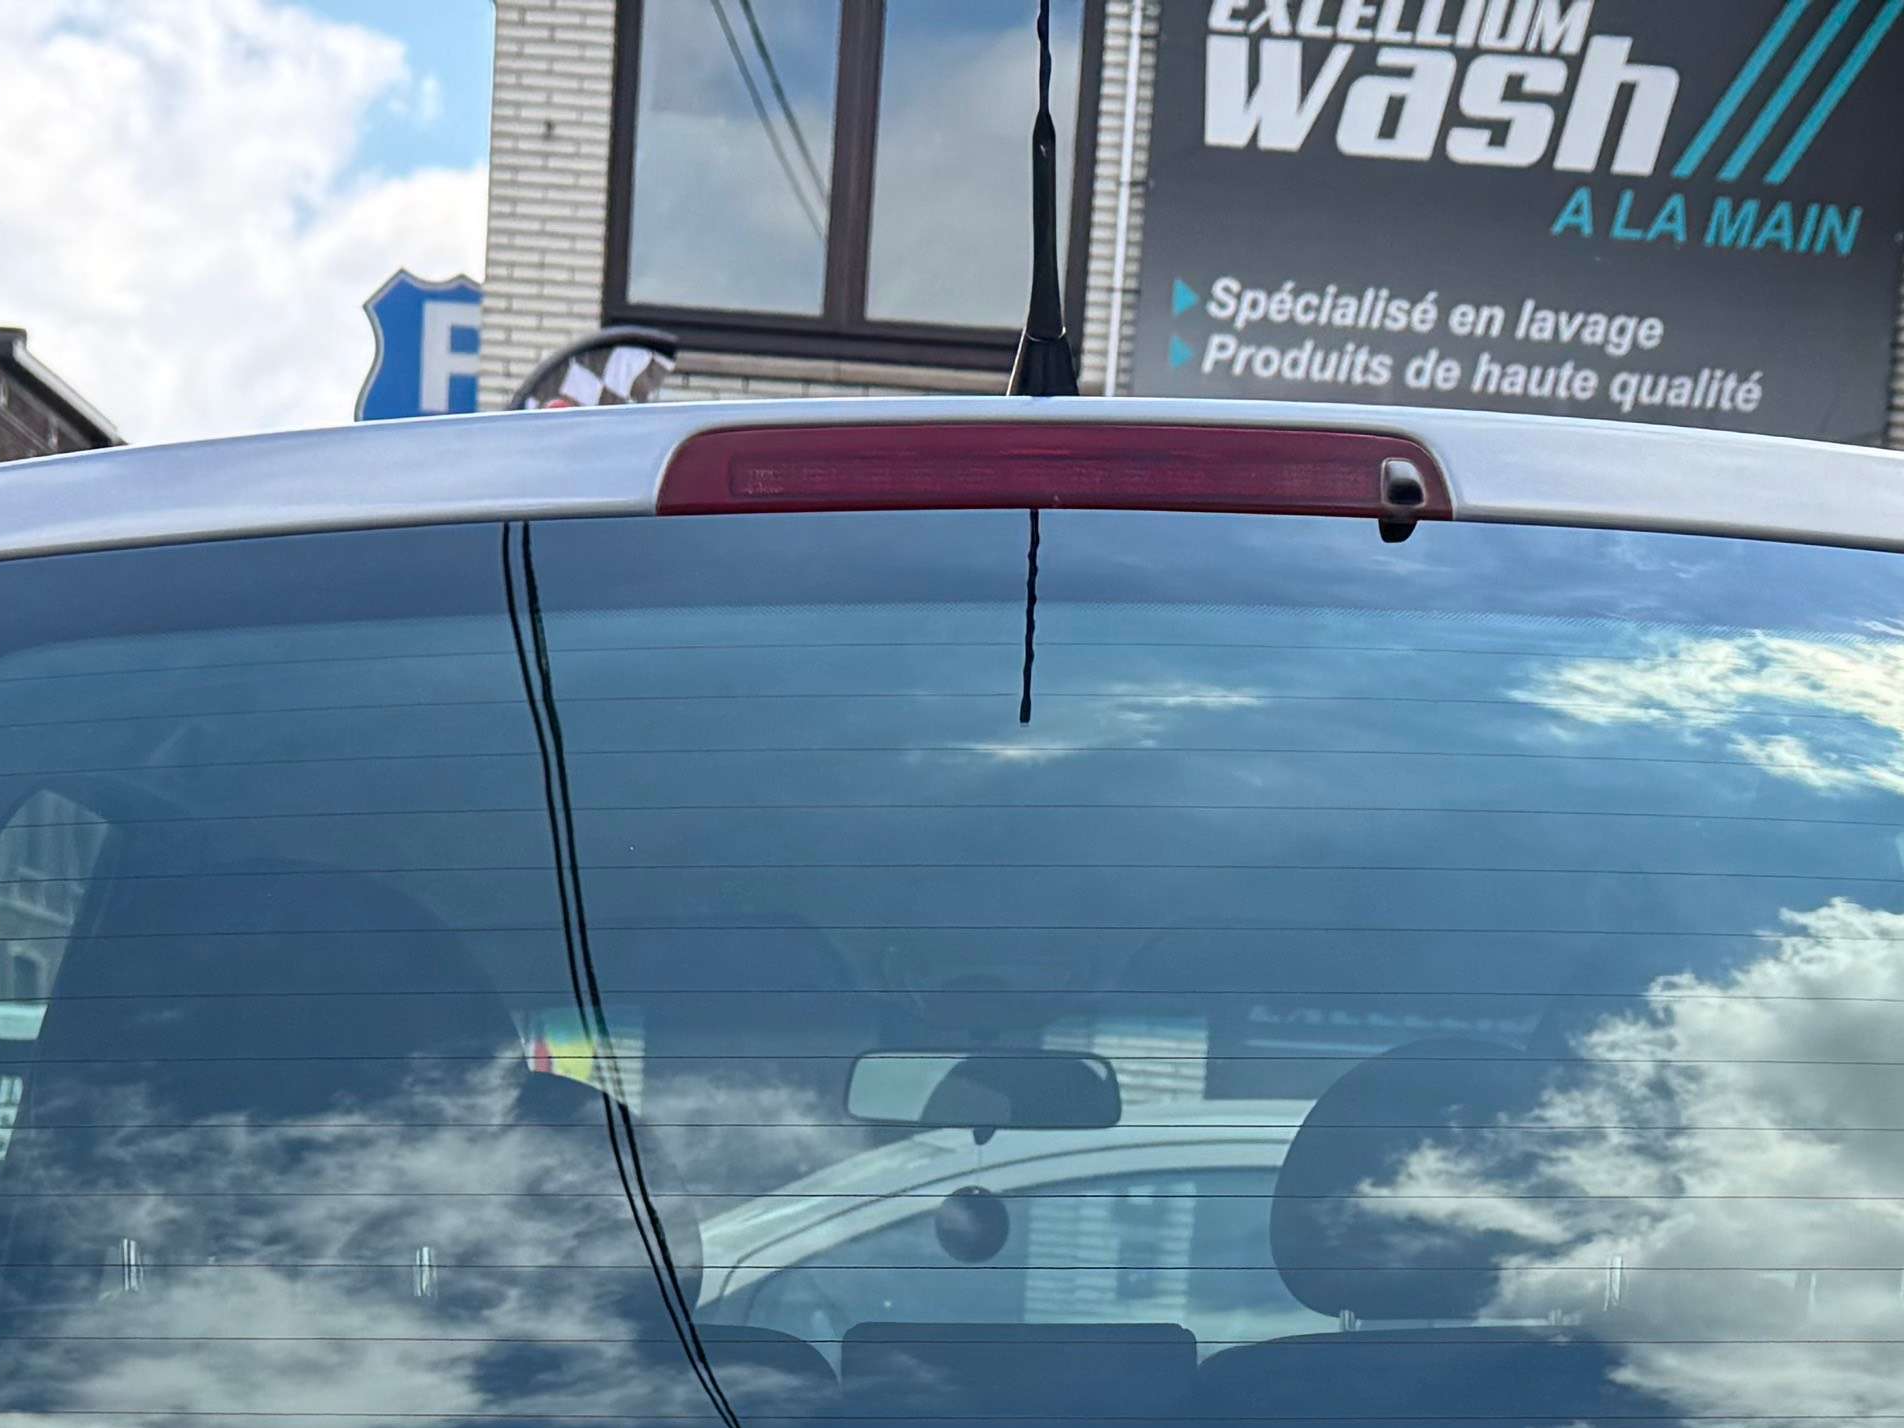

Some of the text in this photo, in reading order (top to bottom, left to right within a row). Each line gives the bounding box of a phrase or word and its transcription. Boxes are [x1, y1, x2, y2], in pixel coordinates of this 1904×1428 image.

[1204, 35, 1680, 177] wash
[1552, 187, 1863, 257] A LA MAIN
[1206, 277, 1665, 358] Spécialisé en lavage
[1201, 332, 1764, 415] Produits de haute qualité
